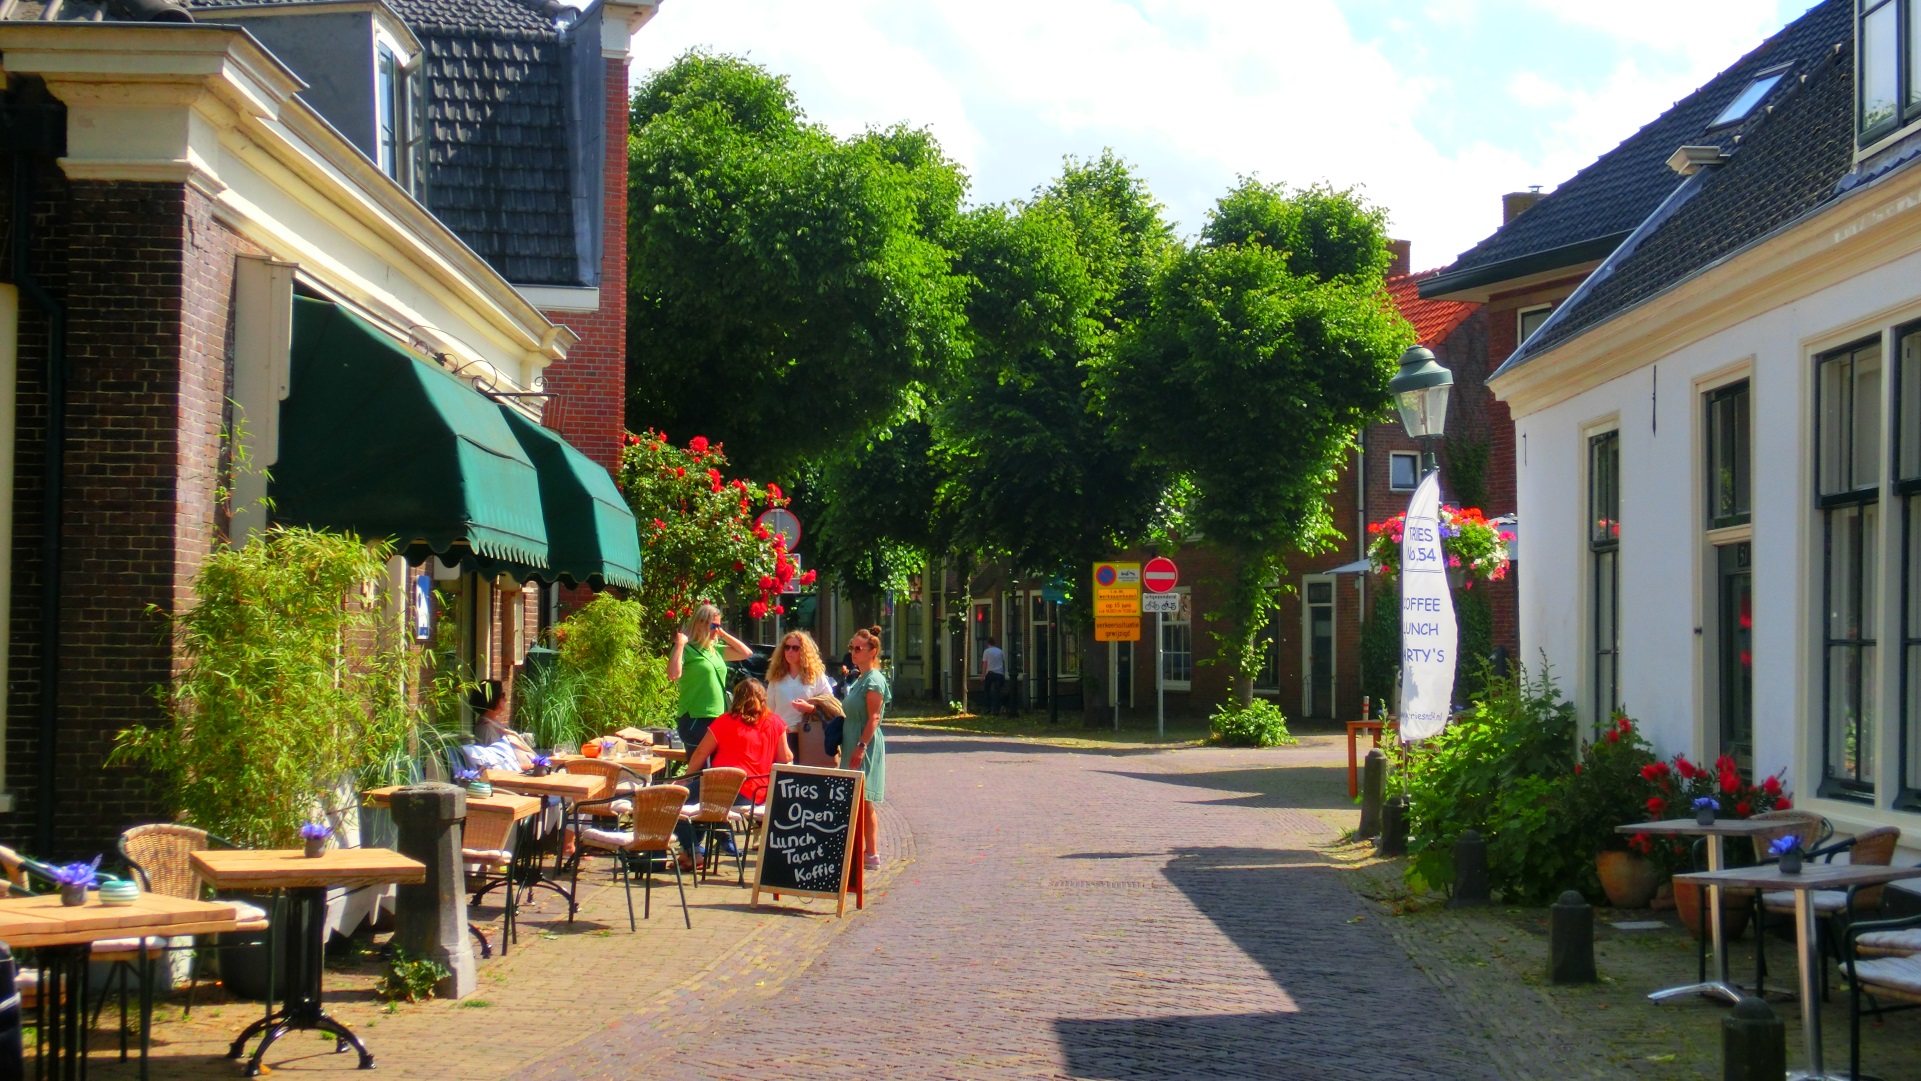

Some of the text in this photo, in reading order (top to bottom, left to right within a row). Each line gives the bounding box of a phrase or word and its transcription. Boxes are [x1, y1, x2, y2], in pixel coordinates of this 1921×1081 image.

[1096, 621, 1139, 629] verkeerssituatie
[1105, 630, 1131, 638] gewijzigd
[778, 779, 846, 801] Tries is
[788, 802, 834, 829] Open
[770, 831, 816, 849] Lunch
[782, 845, 825, 865] Taart
[794, 863, 835, 882] Koffie
